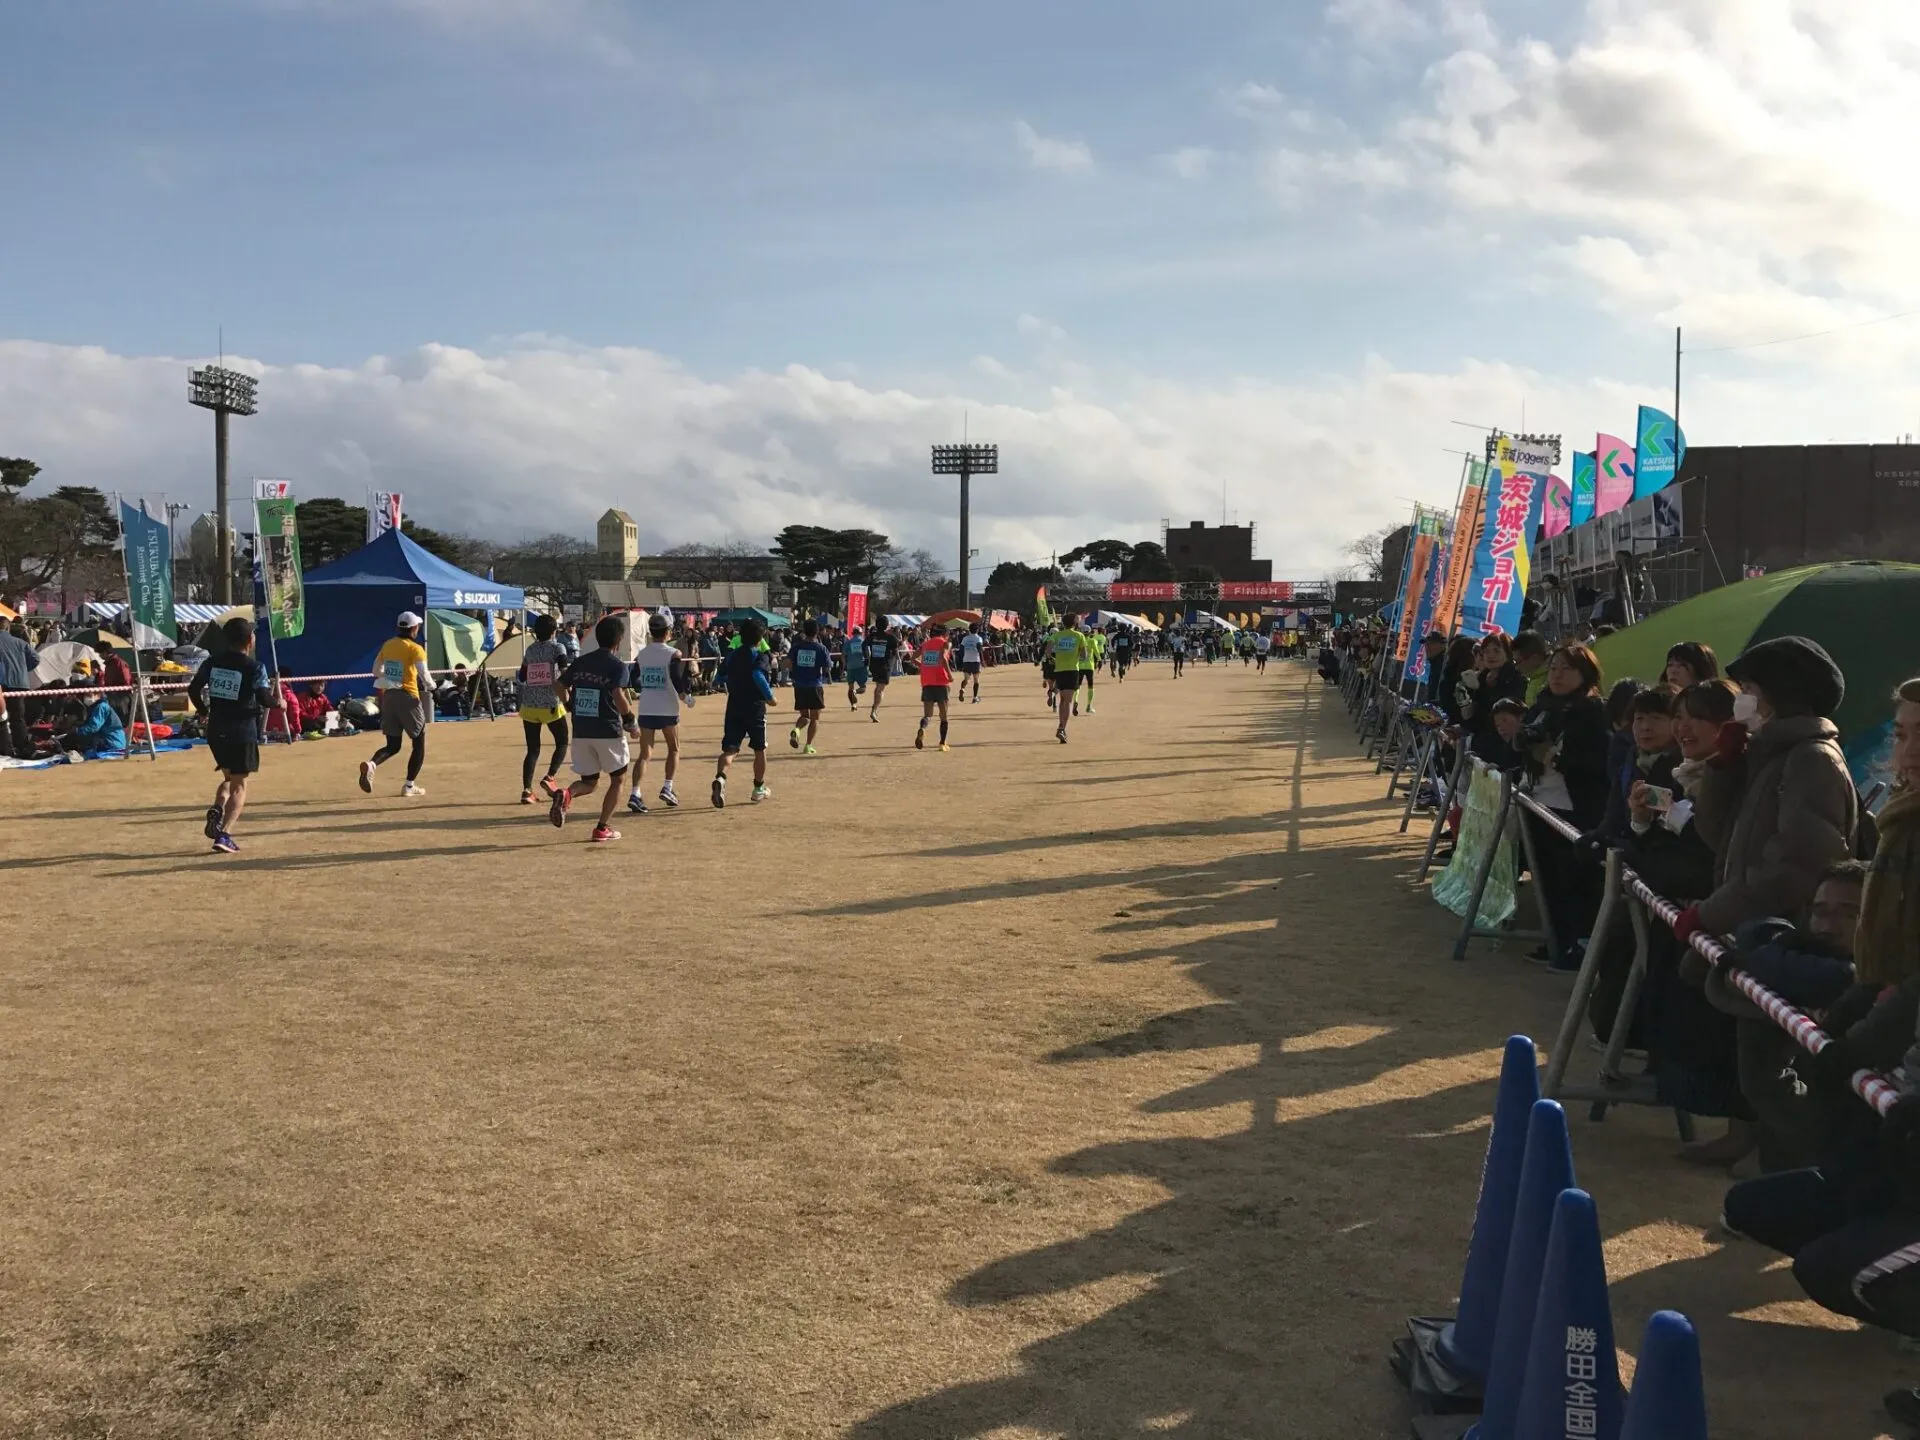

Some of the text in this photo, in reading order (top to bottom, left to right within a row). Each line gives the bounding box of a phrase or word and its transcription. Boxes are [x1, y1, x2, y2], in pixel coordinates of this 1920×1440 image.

[1643, 457, 1675, 465] KATSUT
[136, 546, 150, 606] Running Club
[148, 528, 165, 625] TSUKUBA STRIDES
[1121, 587, 1164, 596] FINISH
[1234, 587, 1278, 596] FINISH
[464, 593, 500, 604] SUZUKI
[1565, 1326, 1597, 1440] 勝田全国
